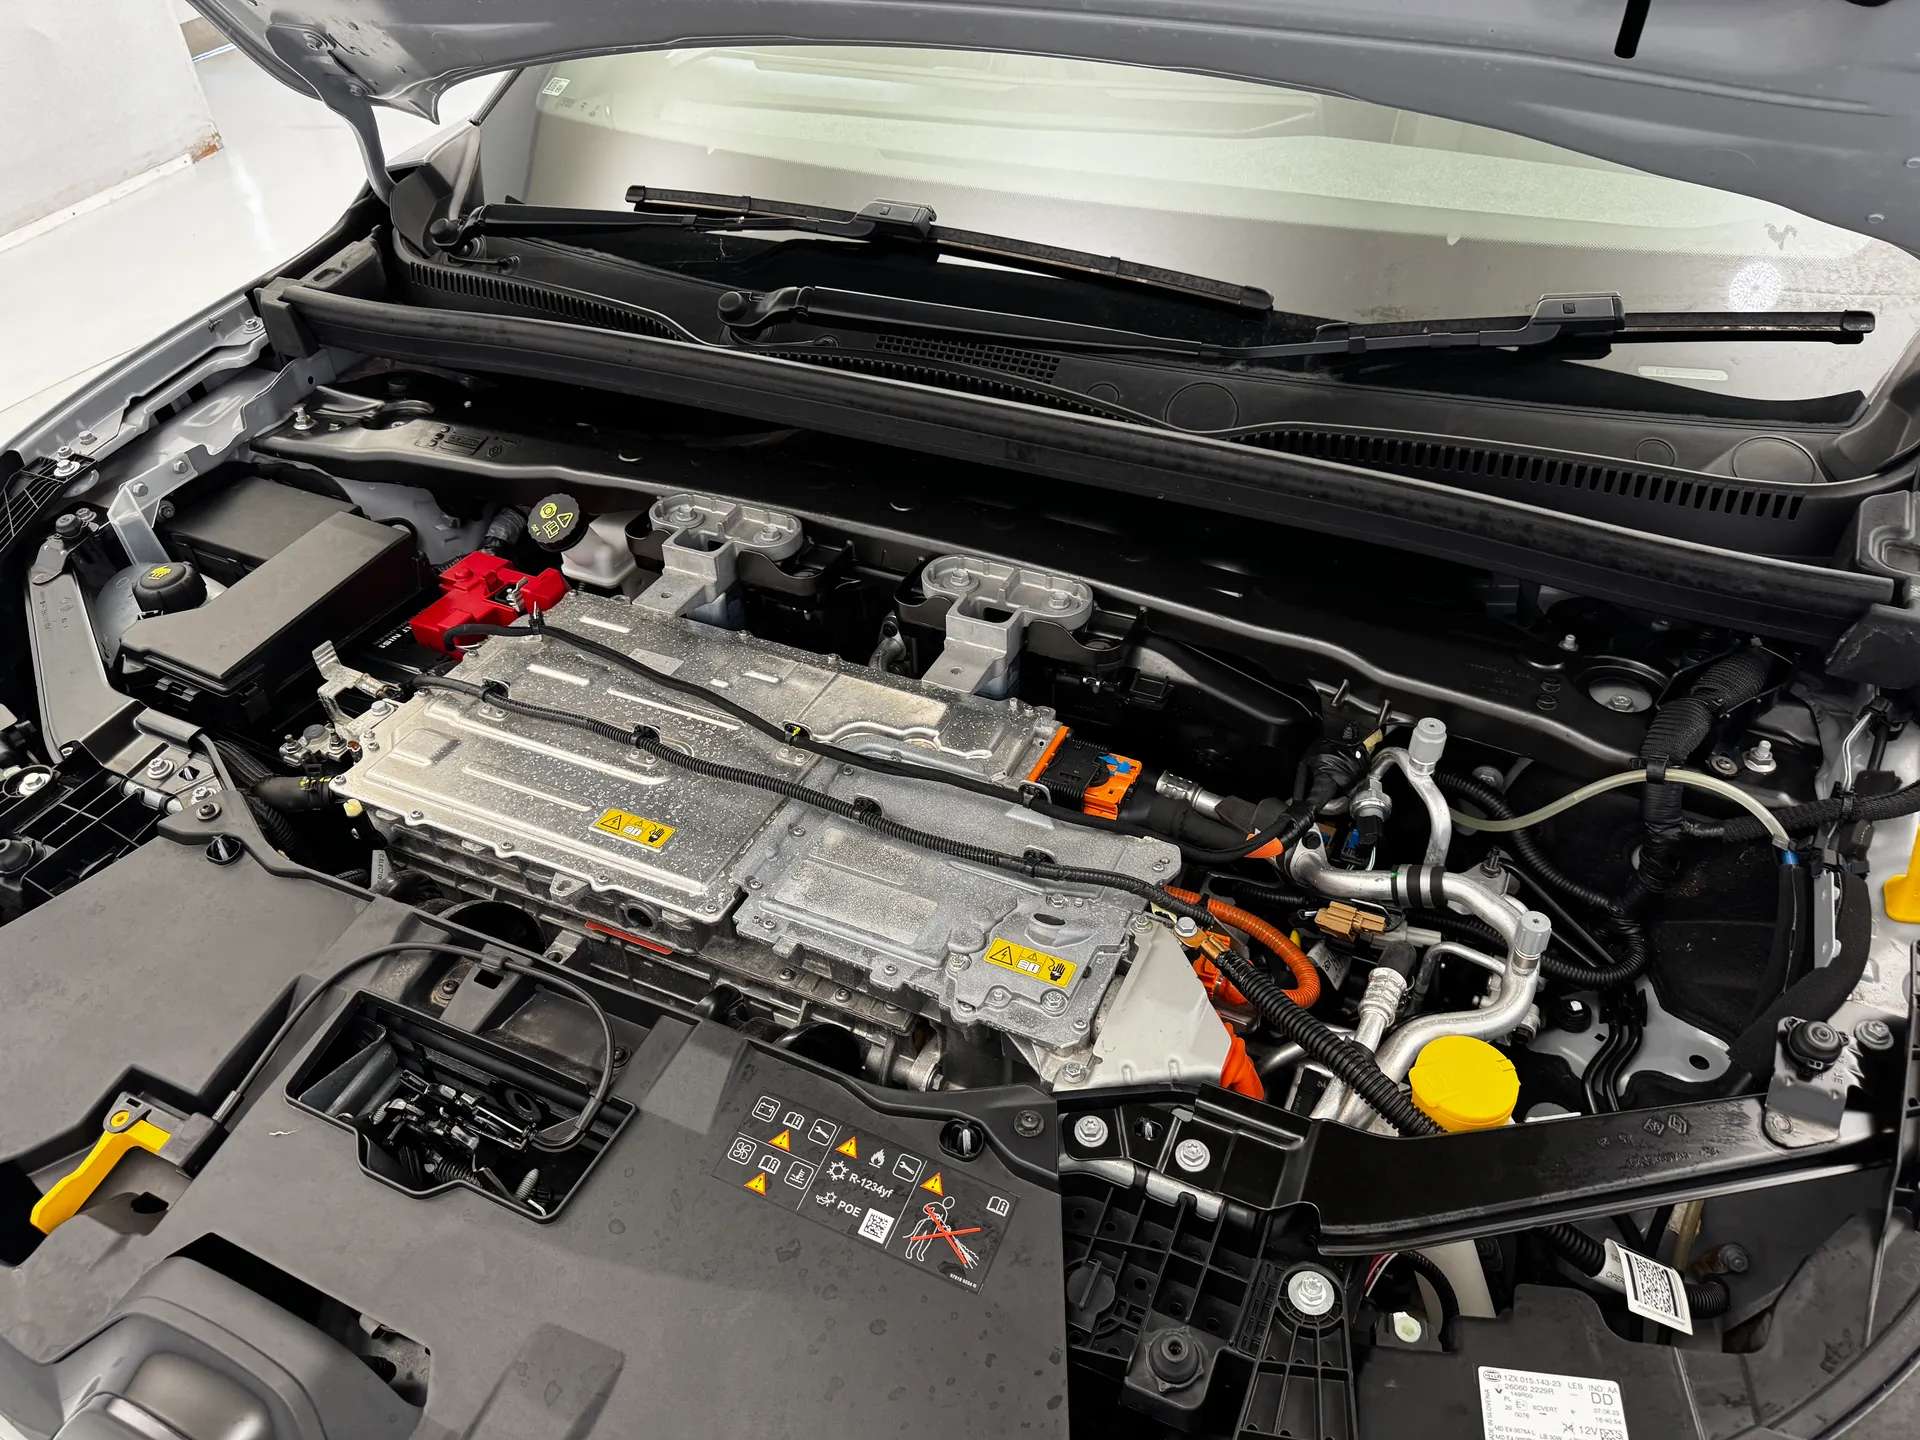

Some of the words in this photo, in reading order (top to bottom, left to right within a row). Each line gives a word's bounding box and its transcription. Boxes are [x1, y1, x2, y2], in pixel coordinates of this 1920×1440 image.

[849, 1173, 894, 1198] R-1234yf
[837, 1200, 862, 1217] POE
[1579, 1426, 1598, 1435] 12V
